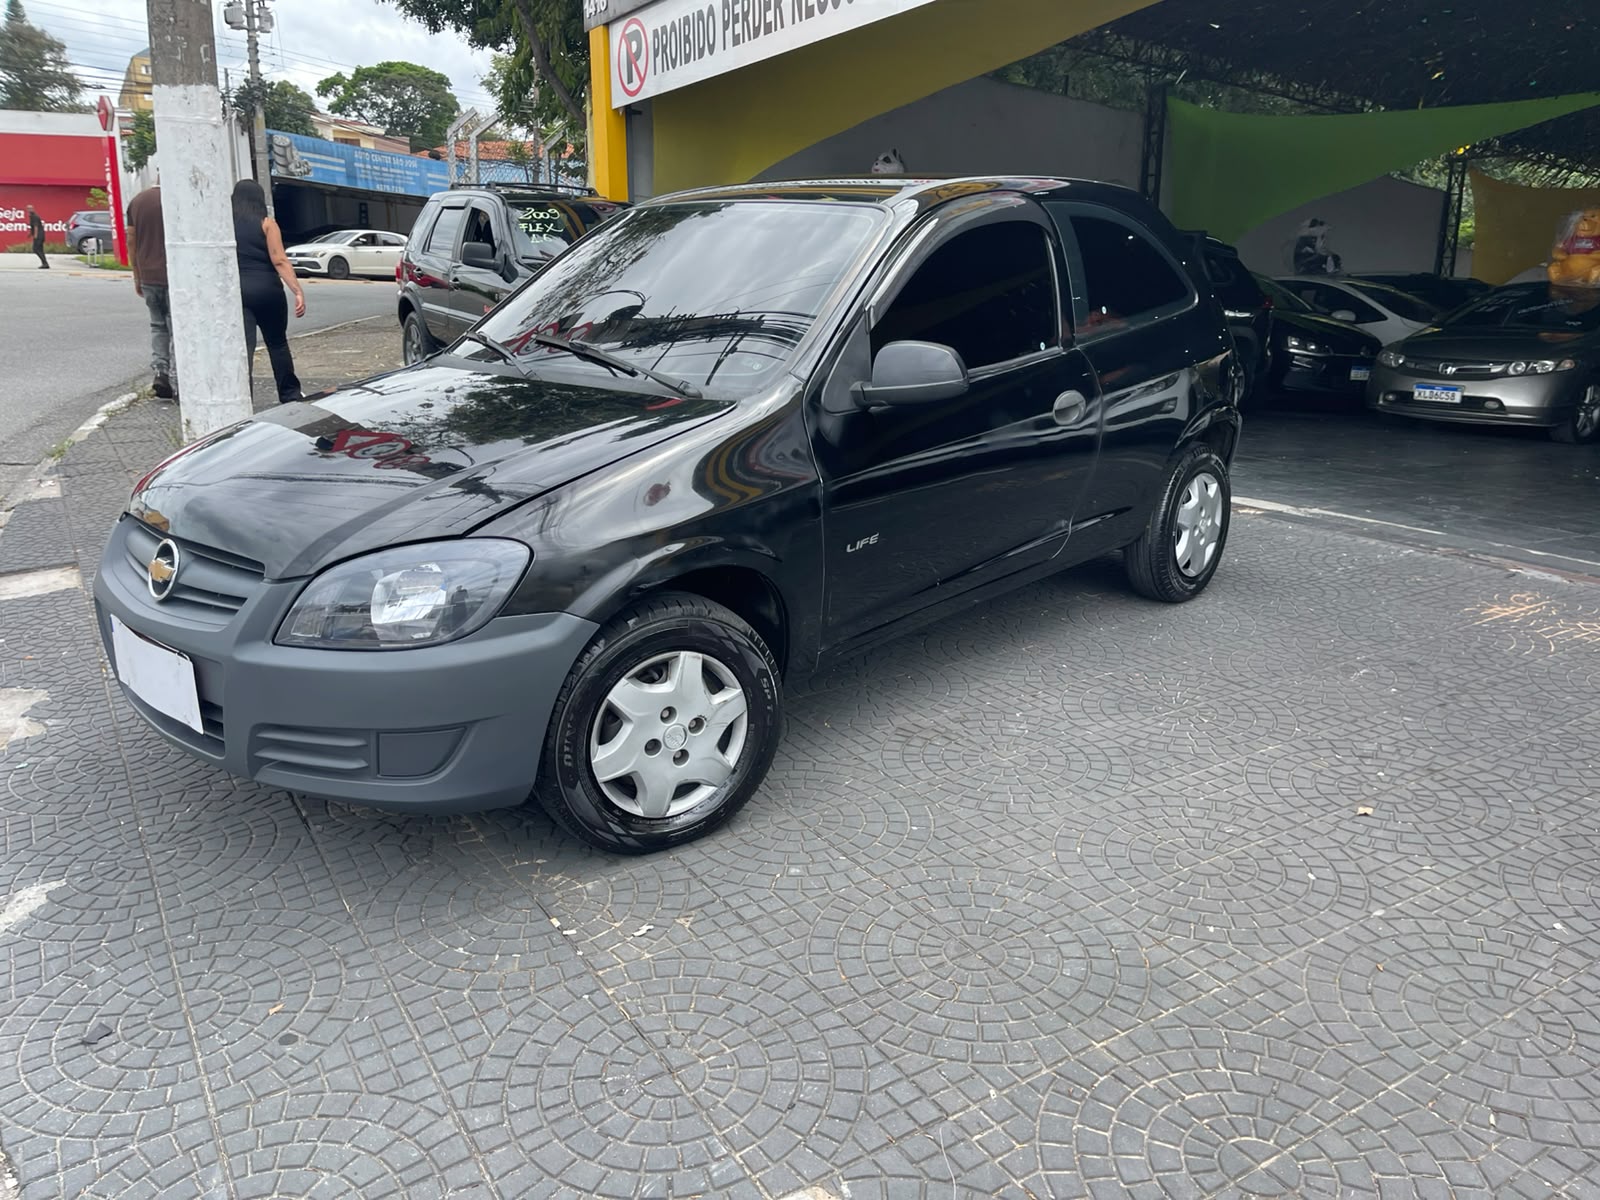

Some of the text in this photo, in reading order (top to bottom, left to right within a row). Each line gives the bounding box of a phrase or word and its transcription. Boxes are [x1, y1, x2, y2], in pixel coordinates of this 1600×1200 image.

[652, 4, 716, 76] PROIBIDO
[721, 0, 785, 51] PERDER
[518, 207, 560, 220] 2009
[518, 222, 564, 233] FLEX
[846, 532, 880, 553] LIFE
